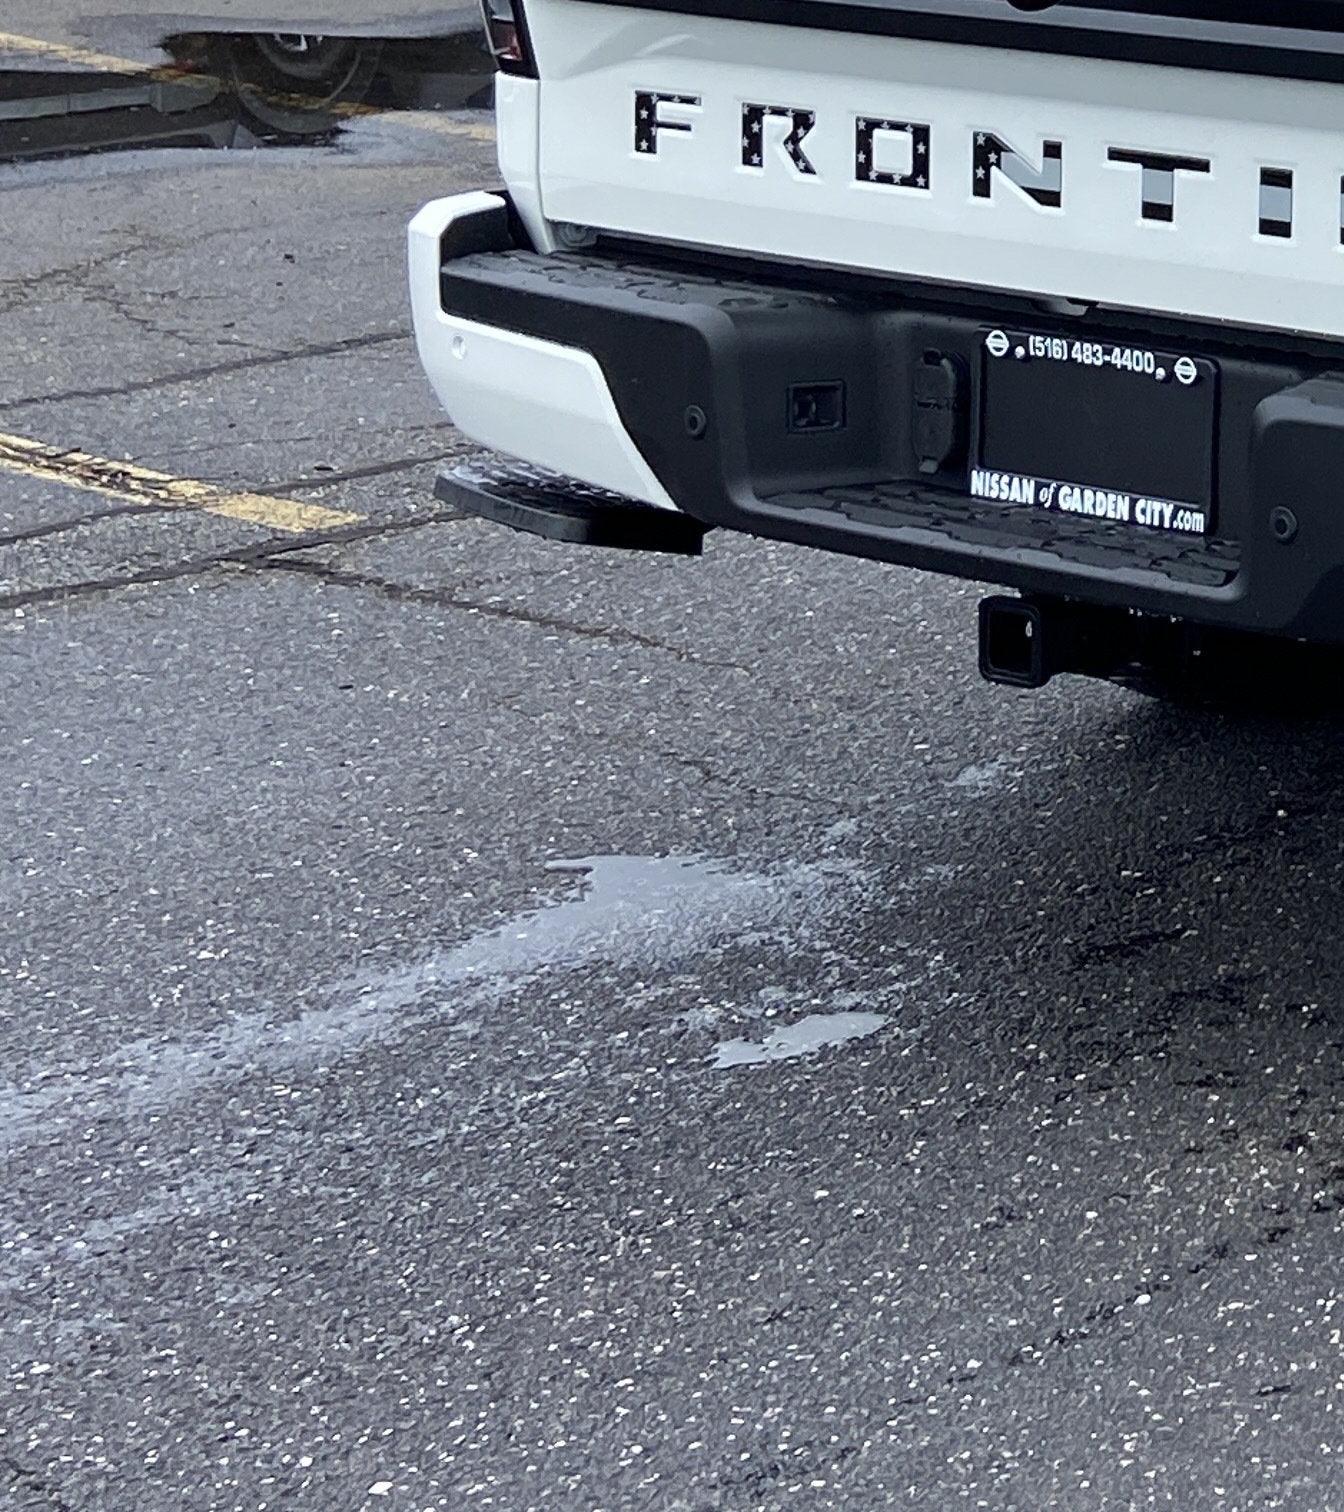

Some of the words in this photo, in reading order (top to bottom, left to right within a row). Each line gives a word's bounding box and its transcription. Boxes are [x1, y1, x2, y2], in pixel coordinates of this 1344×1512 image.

[1029, 335, 1068, 360] (516)
[1071, 344, 1155, 374] 483-4400
[970, 470, 1035, 504] NISSAN
[1038, 482, 1057, 508] of
[1058, 485, 1129, 521] GARDEN
